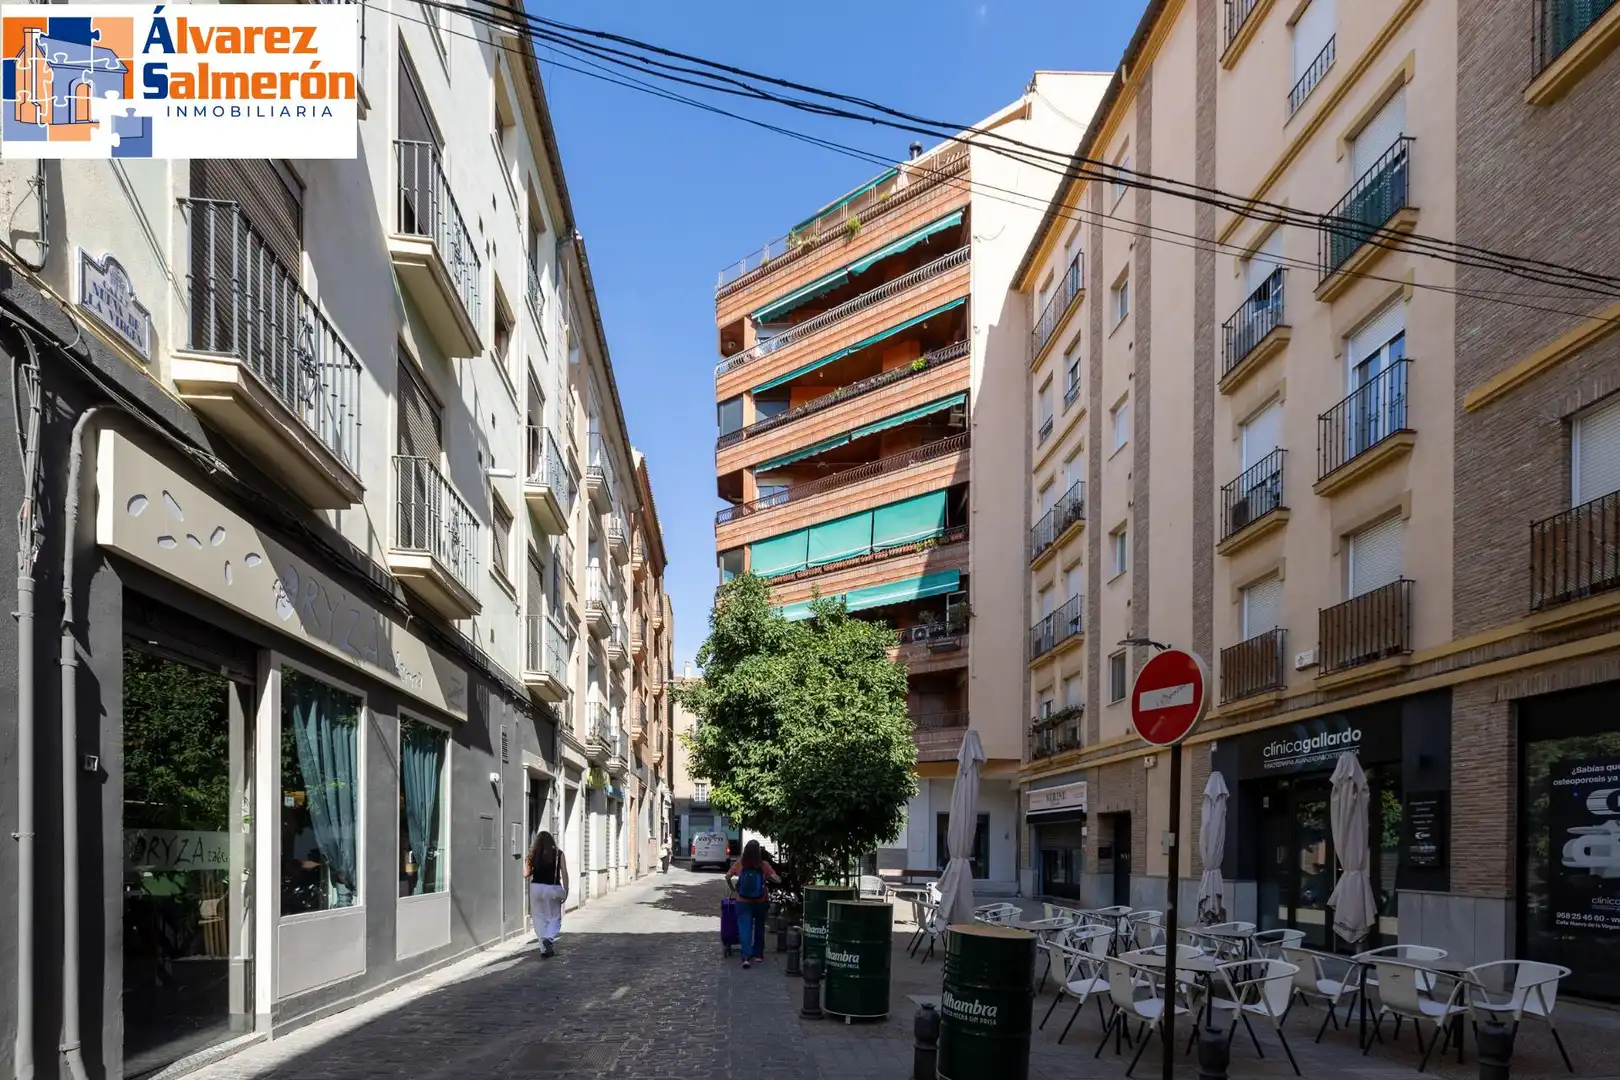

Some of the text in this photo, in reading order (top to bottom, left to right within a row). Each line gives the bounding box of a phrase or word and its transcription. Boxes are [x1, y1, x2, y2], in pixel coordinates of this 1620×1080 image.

[1263, 727, 1362, 758] clínicagallardo
[1571, 764, 1605, 776] ¿Sabías
[1553, 775, 1606, 786] osteoporosis
